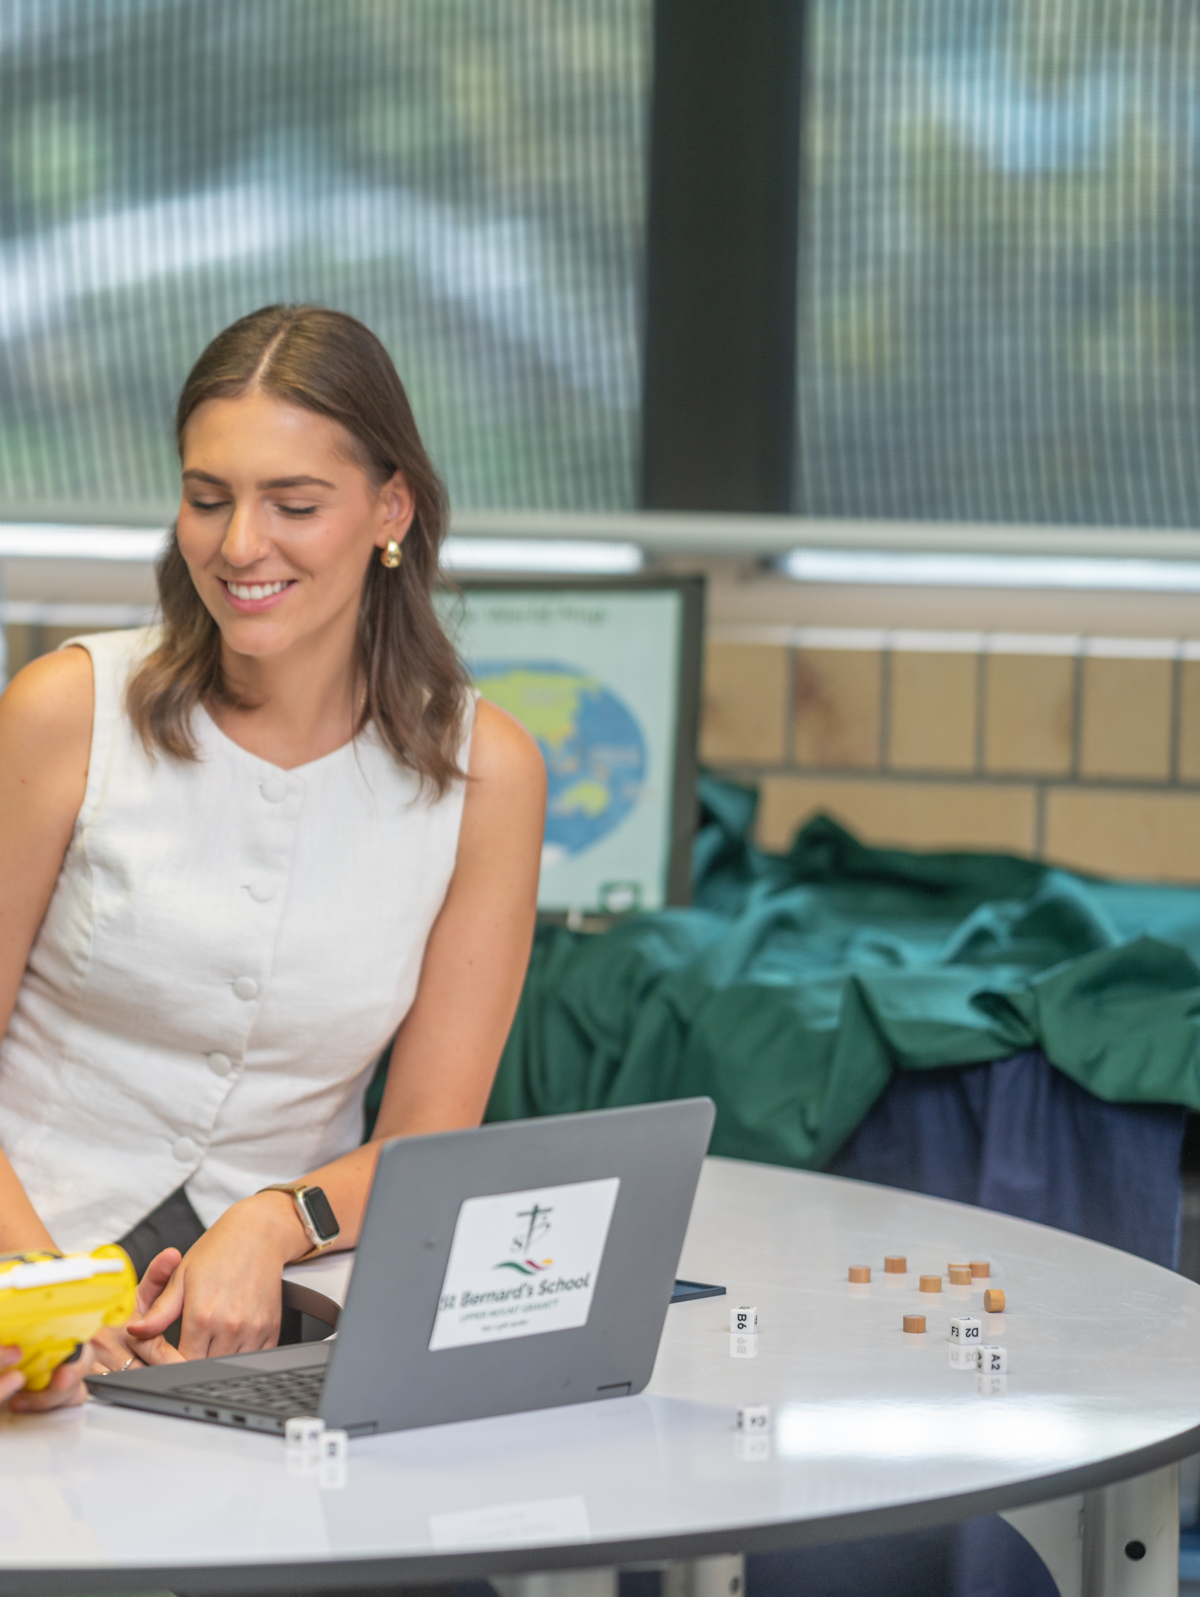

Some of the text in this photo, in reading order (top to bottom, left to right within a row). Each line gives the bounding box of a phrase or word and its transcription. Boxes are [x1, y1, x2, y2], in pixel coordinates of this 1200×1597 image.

[460, 1281, 533, 1308] Bernard's
[538, 1272, 591, 1295] School
[737, 1313, 747, 1330] B6
[951, 1326, 959, 1337] F3
[965, 1327, 979, 1338] D2
[991, 1354, 1001, 1370] A2
